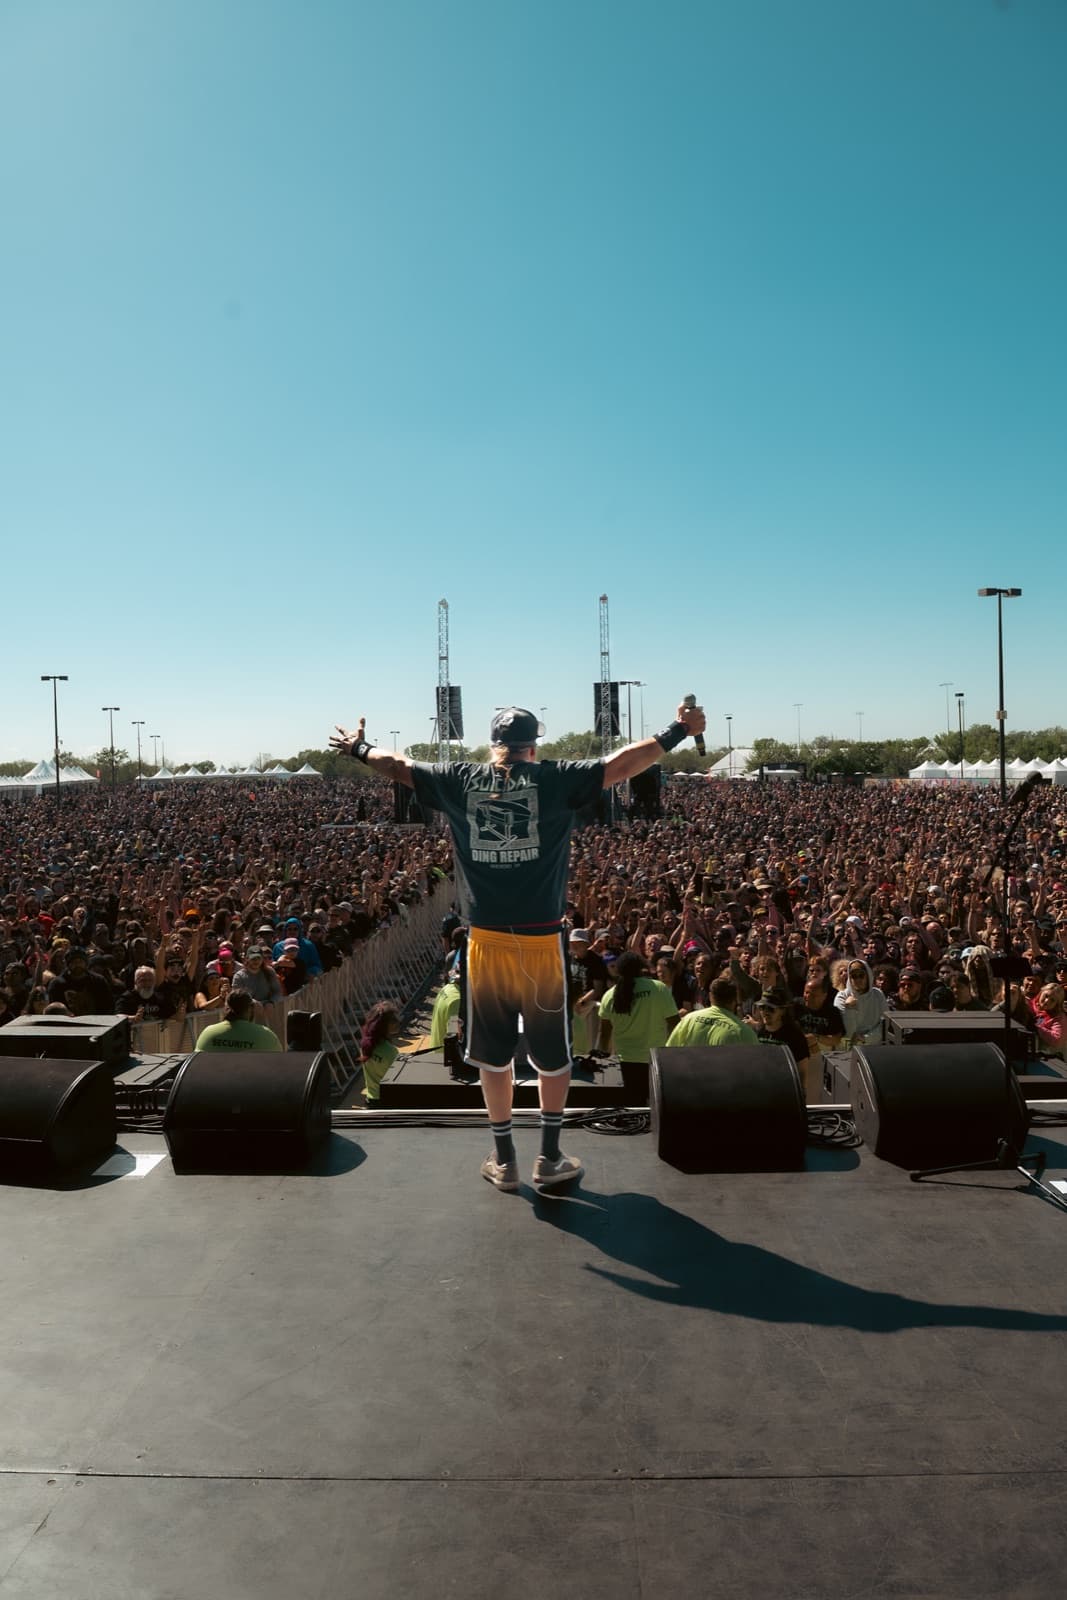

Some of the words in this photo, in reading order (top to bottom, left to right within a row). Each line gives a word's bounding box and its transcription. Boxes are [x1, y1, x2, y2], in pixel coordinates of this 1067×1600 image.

[472, 849, 498, 863] DING
[499, 848, 539, 863] REPAIR
[695, 1016, 733, 1029] SECURITY
[212, 1039, 254, 1048] SECURITY
